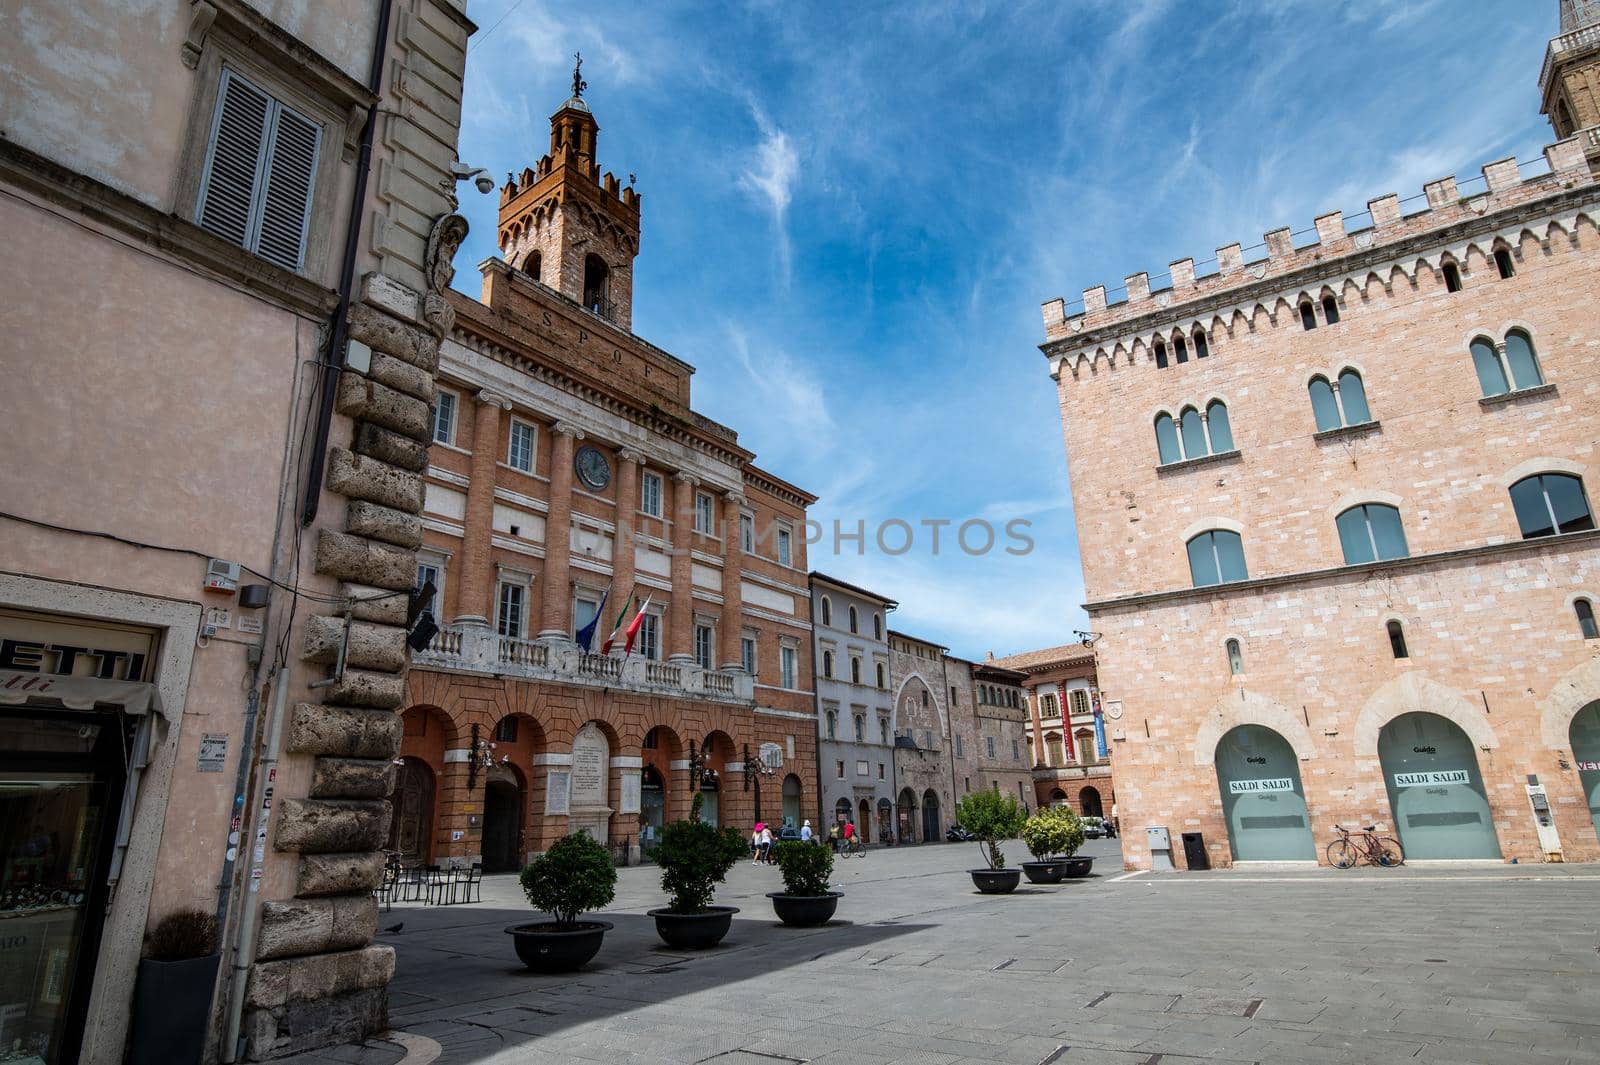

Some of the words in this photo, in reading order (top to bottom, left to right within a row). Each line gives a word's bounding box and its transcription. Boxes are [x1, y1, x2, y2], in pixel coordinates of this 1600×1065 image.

[543, 311, 552, 327] S
[579, 330, 588, 344] P
[613, 349, 622, 365] Q
[213, 612, 227, 624] 19
[1397, 774, 1429, 784] SALDI
[1433, 772, 1466, 782] SALDI
[1231, 781, 1259, 791] SALDI
[1262, 780, 1290, 790] SALDI
